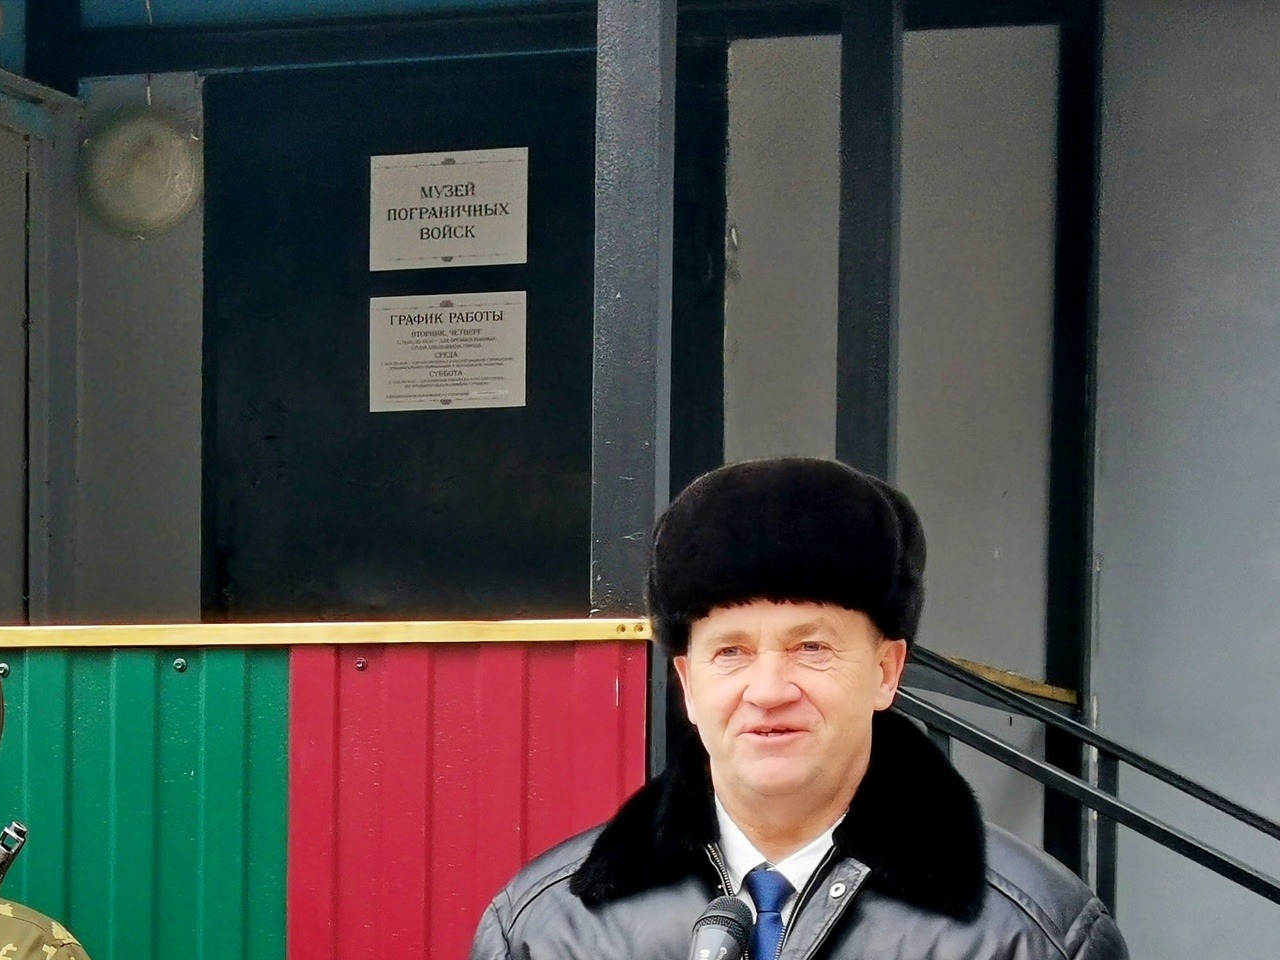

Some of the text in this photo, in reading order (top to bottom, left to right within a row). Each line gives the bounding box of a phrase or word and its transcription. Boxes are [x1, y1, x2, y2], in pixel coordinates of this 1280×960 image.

[420, 182, 476, 199] МУЗЕЙ
[387, 202, 510, 221] ПОГРАНИЧНЫХ
[420, 224, 476, 240] ВОЙСК
[390, 310, 504, 326] ГРАФИК РАБОТЫ
